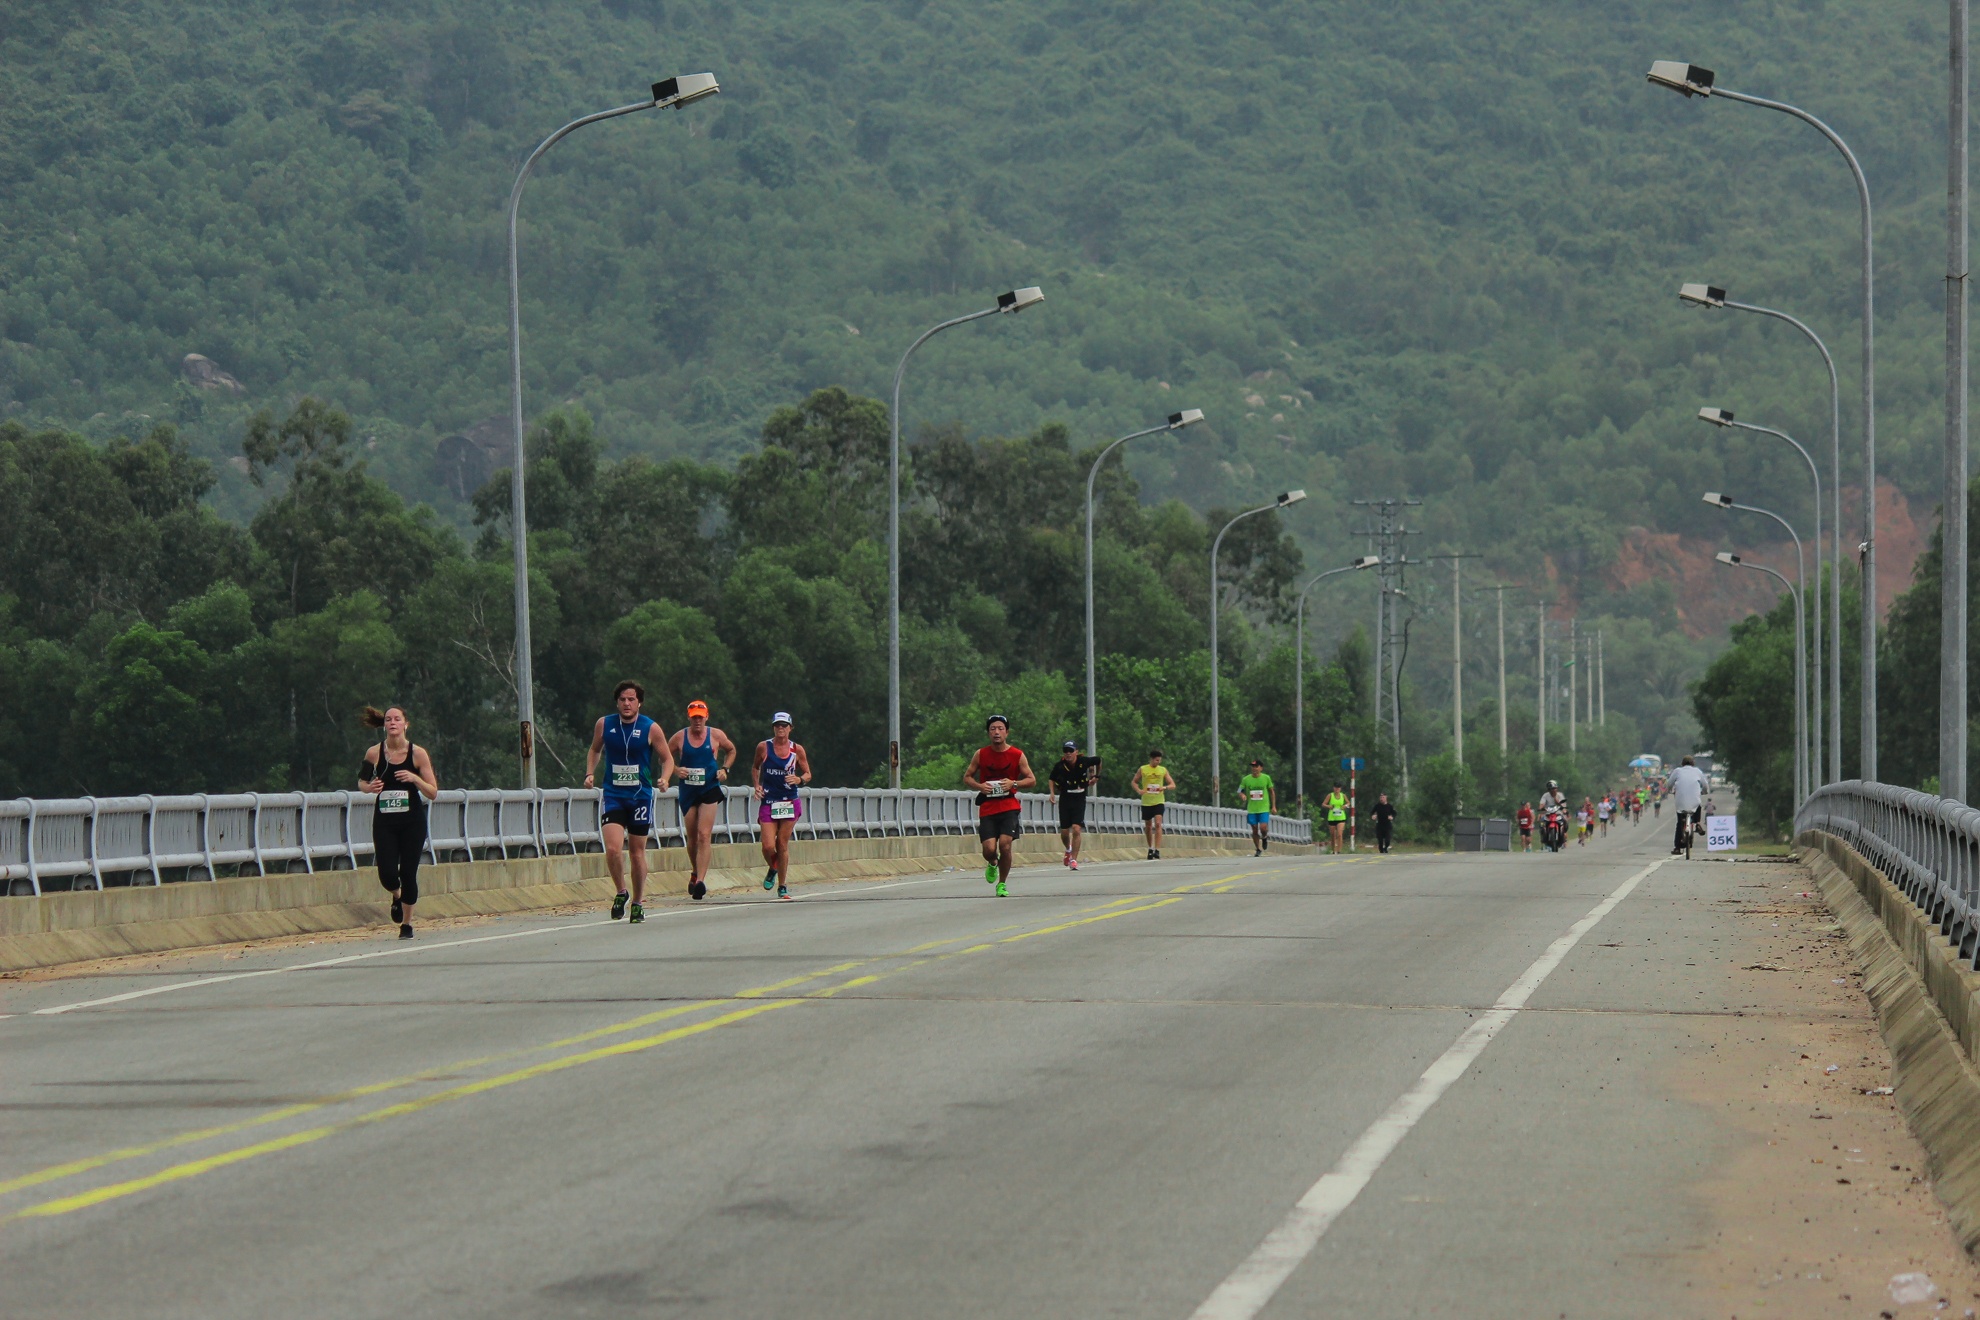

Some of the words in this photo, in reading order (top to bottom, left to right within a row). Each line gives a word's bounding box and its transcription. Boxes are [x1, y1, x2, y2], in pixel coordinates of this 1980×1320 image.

[617, 773, 633, 781] 223
[385, 799, 402, 808] 145
[634, 806, 648, 821] 22
[776, 808, 789, 816] 150
[1709, 835, 1735, 846] 35K
